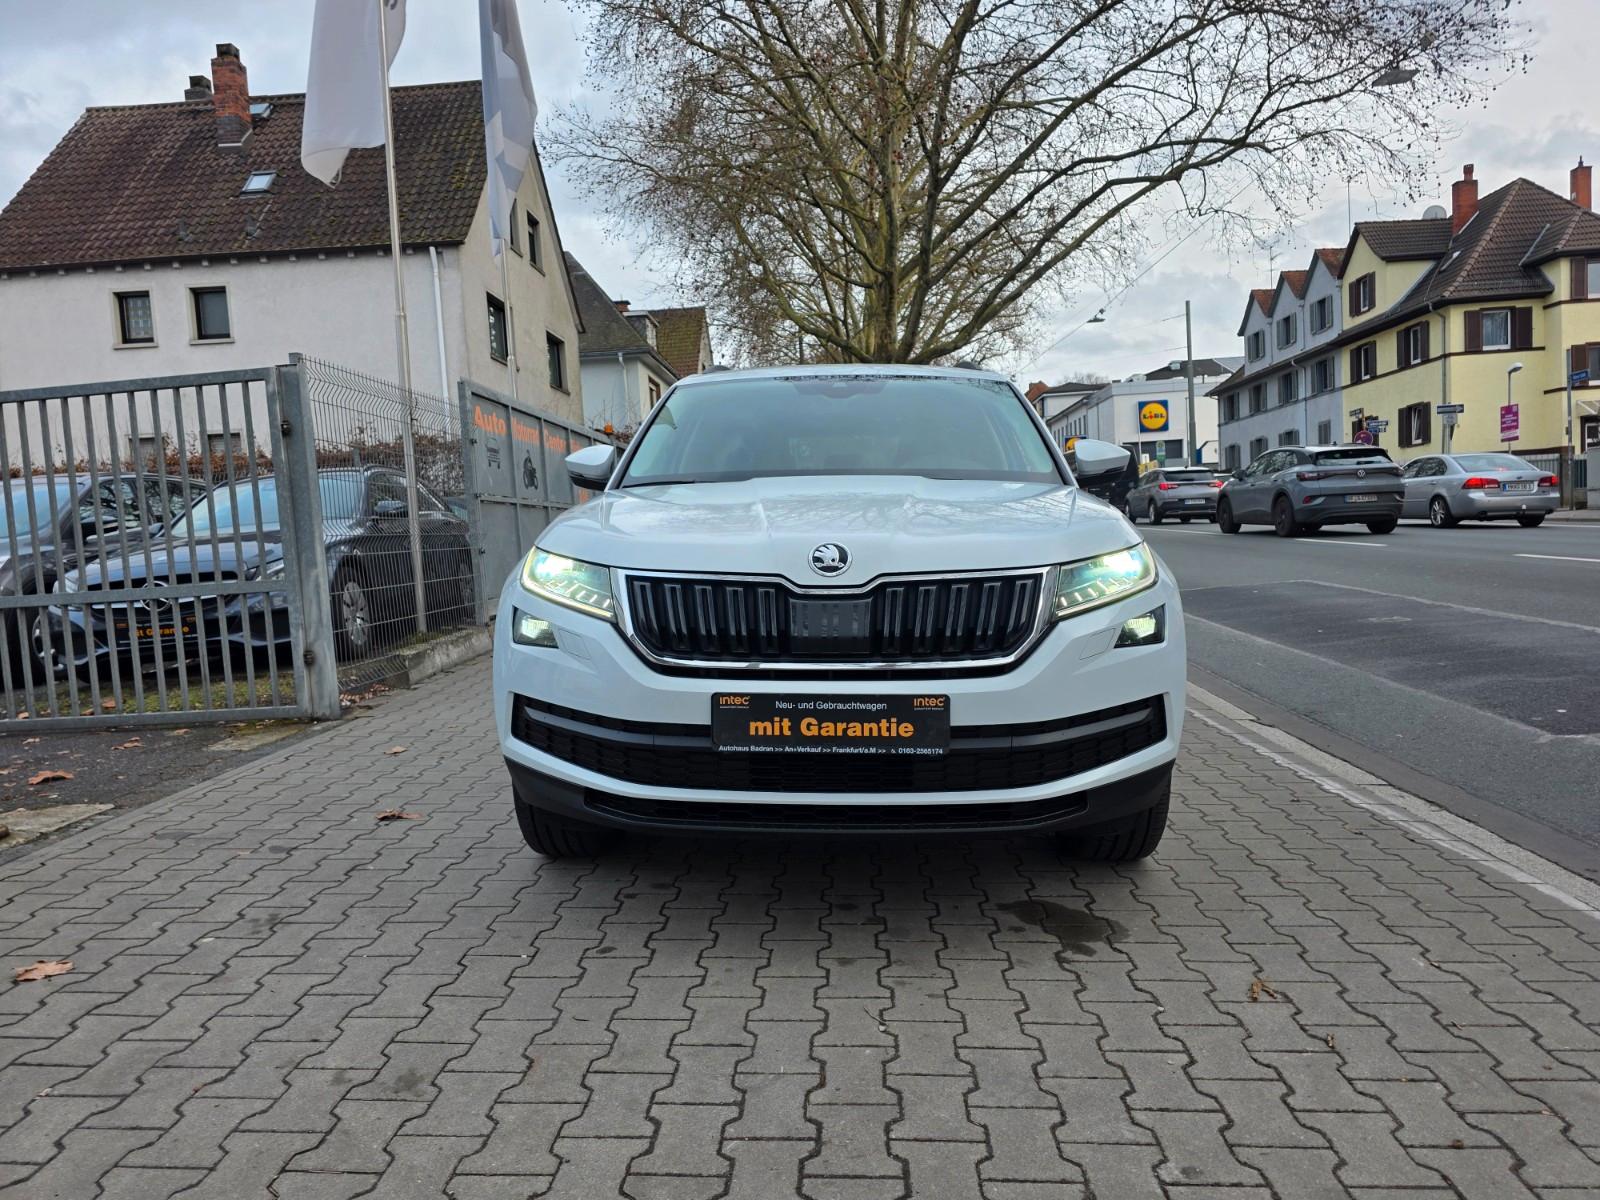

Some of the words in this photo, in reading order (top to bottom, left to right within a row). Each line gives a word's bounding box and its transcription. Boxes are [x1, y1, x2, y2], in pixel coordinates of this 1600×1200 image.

[474, 405, 506, 434] Auto
[719, 696, 750, 705] intec
[913, 697, 945, 706] intec
[775, 701, 796, 710] Neu-
[798, 701, 814, 710] und
[816, 701, 887, 712] Gebrauchtwagen
[749, 717, 792, 736] mit
[800, 717, 914, 737] Garantie
